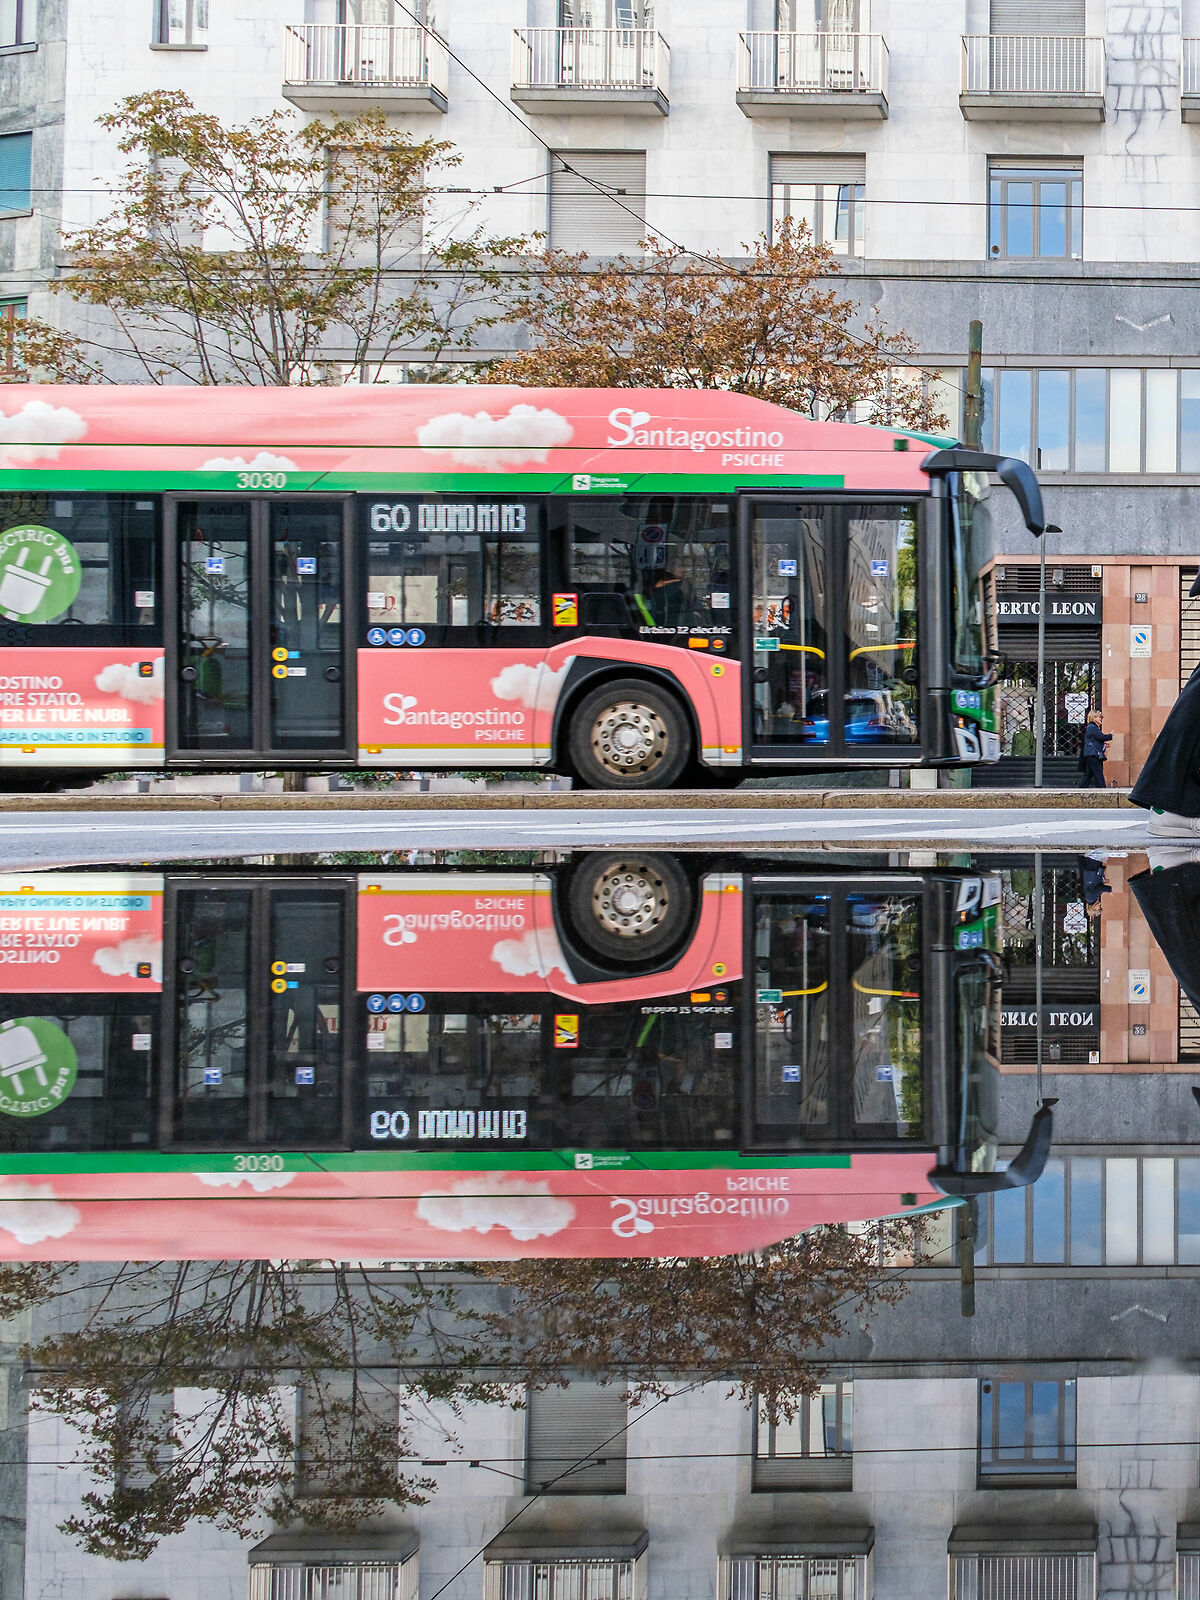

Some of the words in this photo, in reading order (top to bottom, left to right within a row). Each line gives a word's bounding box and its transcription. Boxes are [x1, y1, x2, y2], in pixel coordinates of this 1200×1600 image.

[607, 407, 784, 453] Santagostino
[722, 454, 784, 466] PSICHE
[236, 473, 287, 489] 3030
[371, 504, 411, 531] 60
[54, 543, 74, 574] bus
[1136, 594, 1147, 602] 28
[1052, 602, 1096, 615] LEON
[28, 692, 84, 706] STATO.
[27, 708, 46, 722] LE
[48, 708, 82, 722] TUE
[84, 708, 131, 722] NUBI.
[383, 693, 524, 729] Santagostino
[31, 732, 73, 741] ONLINE
[76, 732, 84, 741] O
[87, 732, 99, 741] IN
[101, 732, 145, 741] STUDIO
[475, 730, 524, 741] PSICHE
